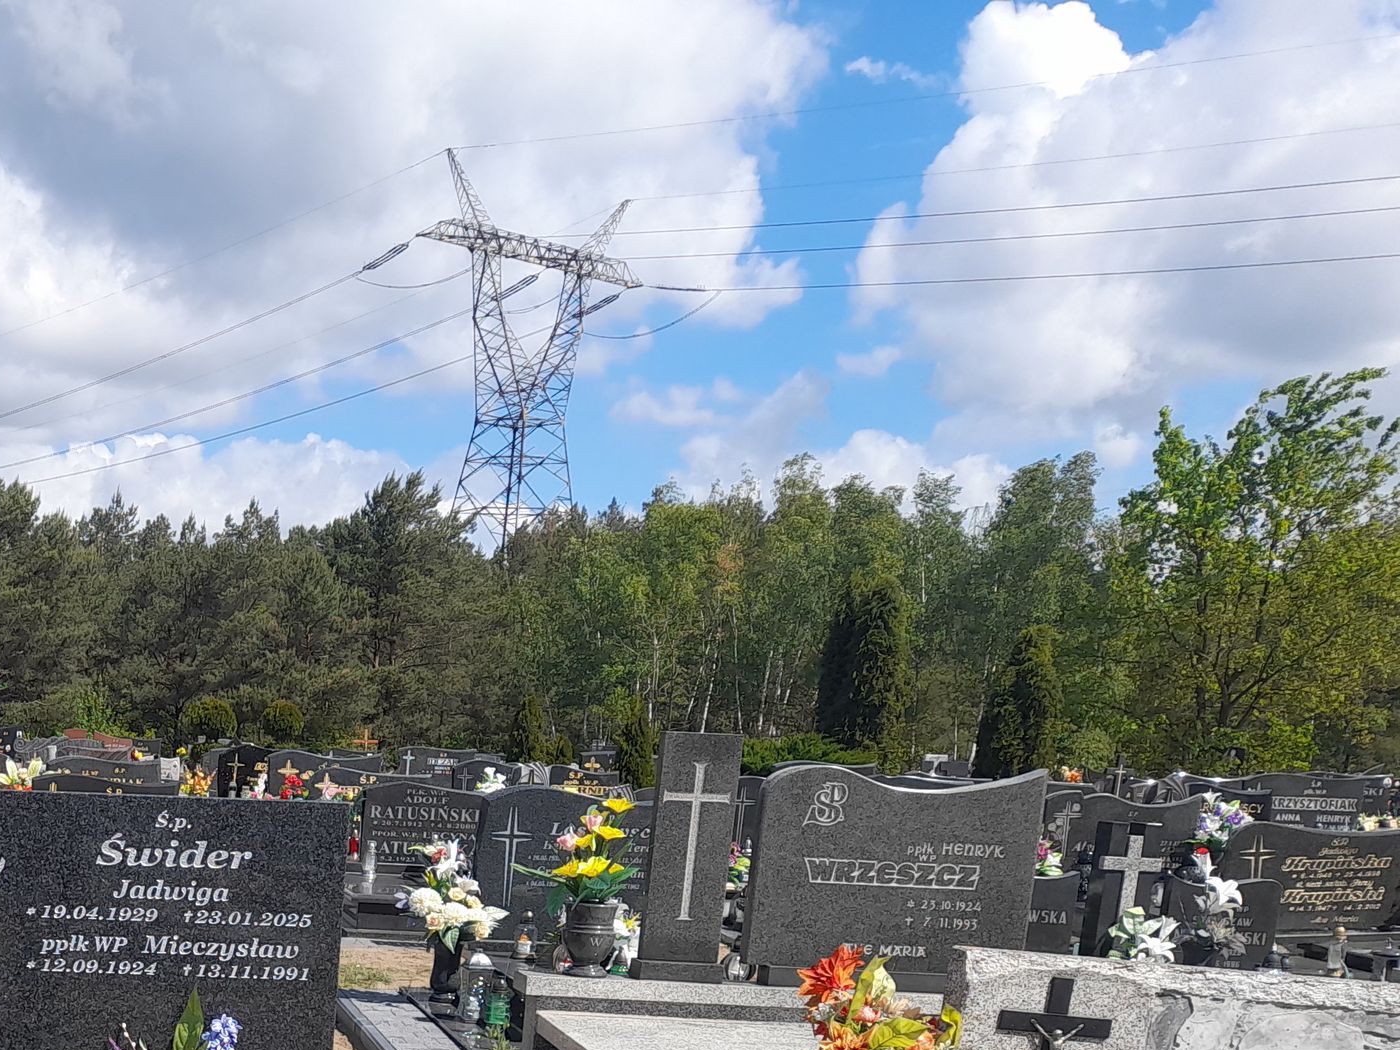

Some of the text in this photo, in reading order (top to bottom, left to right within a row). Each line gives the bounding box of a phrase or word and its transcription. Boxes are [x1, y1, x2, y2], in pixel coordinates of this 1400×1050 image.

[404, 796, 450, 805] ADOLF
[1272, 797, 1357, 811] KRZYSZTOFIAK
[155, 810, 192, 832] Ś.p.
[370, 805, 480, 823] RATUSIŃSKI
[1276, 813, 1351, 823] ANNA HENRYK
[96, 832, 252, 870] Świder
[907, 842, 1005, 859] ppłk HENRYK
[1281, 854, 1392, 872] Krupińska
[804, 857, 980, 890] WRZESZCZ
[113, 879, 229, 906] Jadwiga
[1281, 886, 1385, 904] Krupiński
[40, 905, 312, 928] 19.04.1929 23.01.2025
[1029, 909, 1067, 924] WSKA
[40, 935, 299, 961] ppłk WP Mieczysław
[879, 945, 927, 958] MARIA
[40, 958, 310, 981] 12.09.1924 13.11.1991
